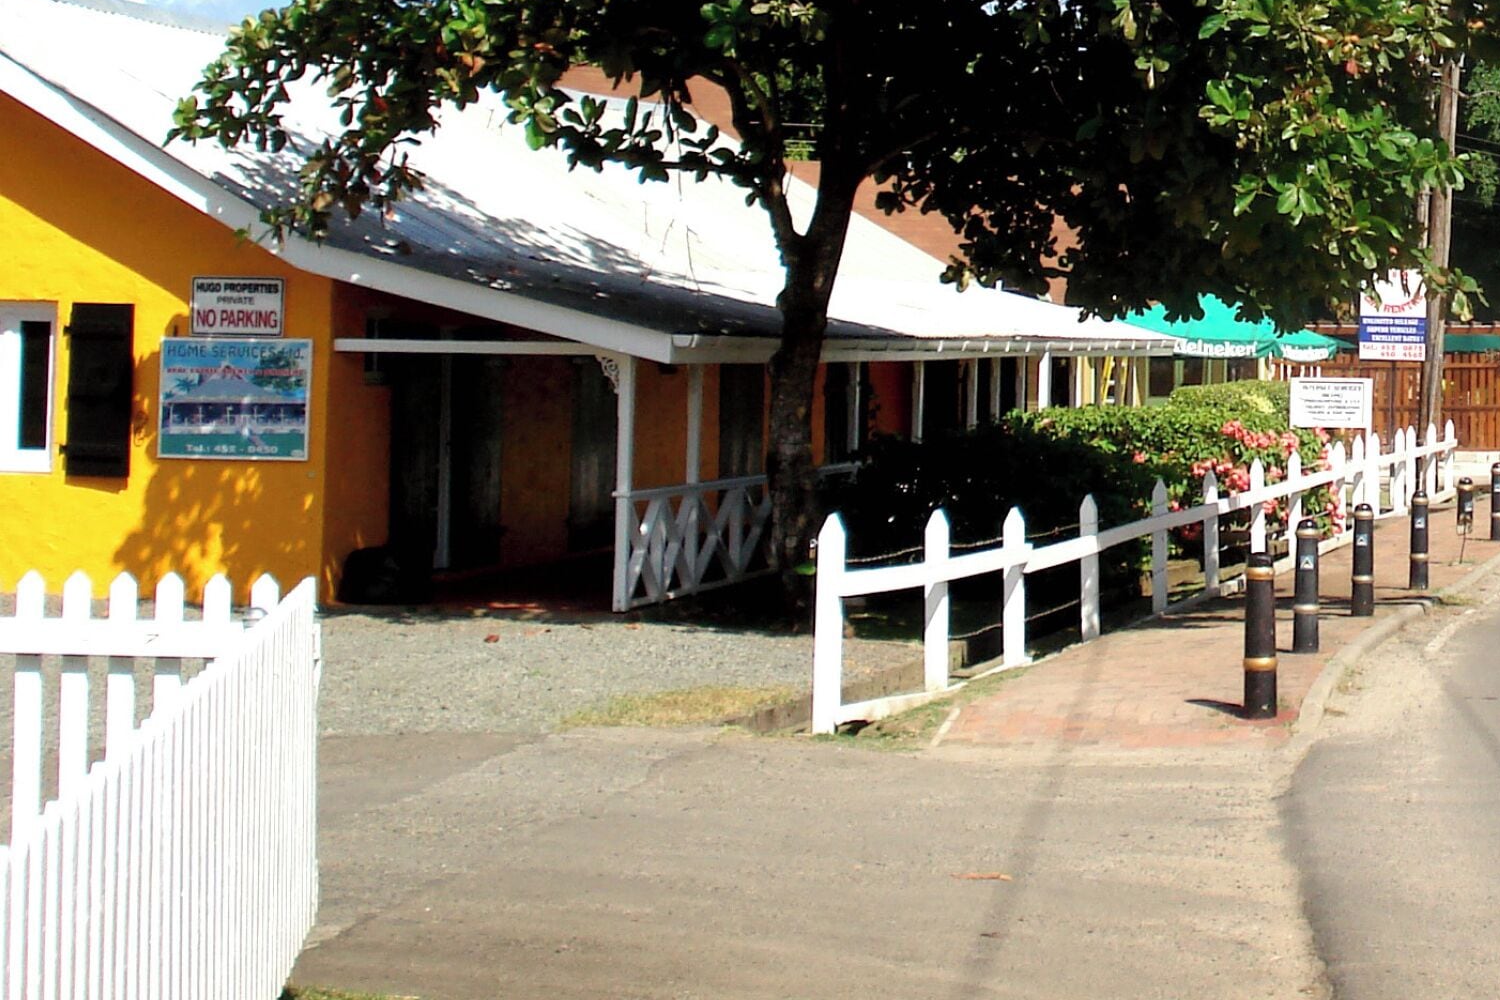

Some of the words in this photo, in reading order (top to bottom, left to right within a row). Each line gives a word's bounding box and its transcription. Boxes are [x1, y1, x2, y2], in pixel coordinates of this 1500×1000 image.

[196, 282, 222, 293] HUGO
[224, 283, 279, 294] PROPERTIES
[216, 296, 255, 305] PRIVATE
[196, 309, 216, 327] NO
[220, 310, 278, 328] PARKING
[167, 345, 207, 358] HOME
[212, 346, 276, 359] SERVICES
